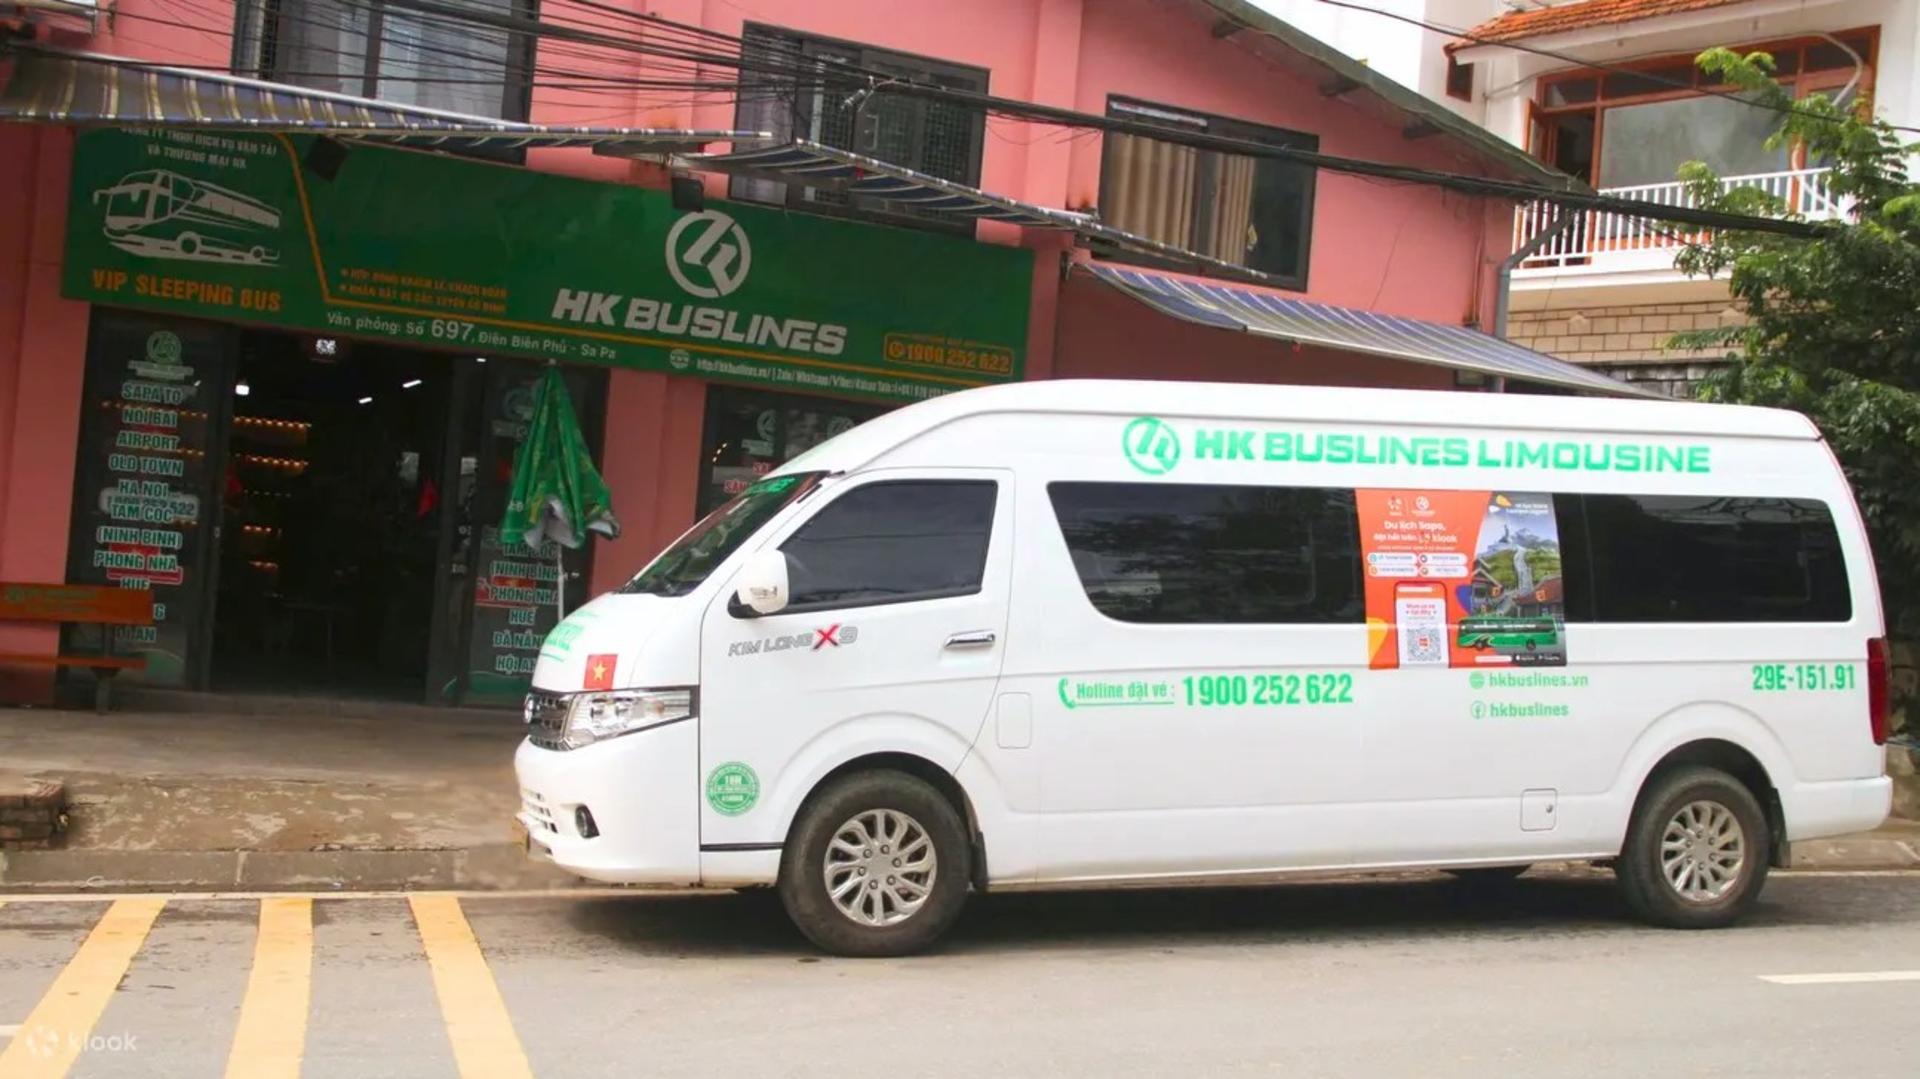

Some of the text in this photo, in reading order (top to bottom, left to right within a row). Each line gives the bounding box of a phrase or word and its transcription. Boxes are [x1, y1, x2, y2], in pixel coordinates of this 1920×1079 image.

[92, 268, 282, 312] VIP SLEEPING BUS
[551, 287, 848, 356] HK BUSLINES
[327, 312, 350, 328] Văn
[405, 320, 424, 337] Số
[580, 343, 597, 358] Sa
[599, 346, 616, 360] Pa
[906, 343, 1011, 373] 1900 252 622
[122, 382, 183, 405] SAPA TO
[122, 409, 178, 429] NOI BAI
[117, 430, 181, 450] AIRPORT
[1194, 429, 1710, 474] HK BUSLINES LIMOUSINE
[109, 454, 185, 477] OLD TOWN
[118, 480, 169, 499] HA NOI
[110, 503, 175, 525] TAM COC
[97, 526, 184, 551] (NINH BINH)
[94, 550, 178, 573] PHONG NHA
[728, 638, 764, 657] KIM
[763, 631, 814, 653] LONG
[1076, 681, 1124, 699] Hotline
[1127, 679, 1150, 702] đặt
[1152, 680, 1168, 698] vé
[1182, 674, 1248, 706] 1900
[1251, 674, 1301, 705] 252
[1305, 672, 1354, 704] 622
[1488, 672, 1589, 688] hkbuslines.vn
[1752, 663, 1856, 691] 29E-151.91
[1489, 702, 1570, 718] hkbuslines
